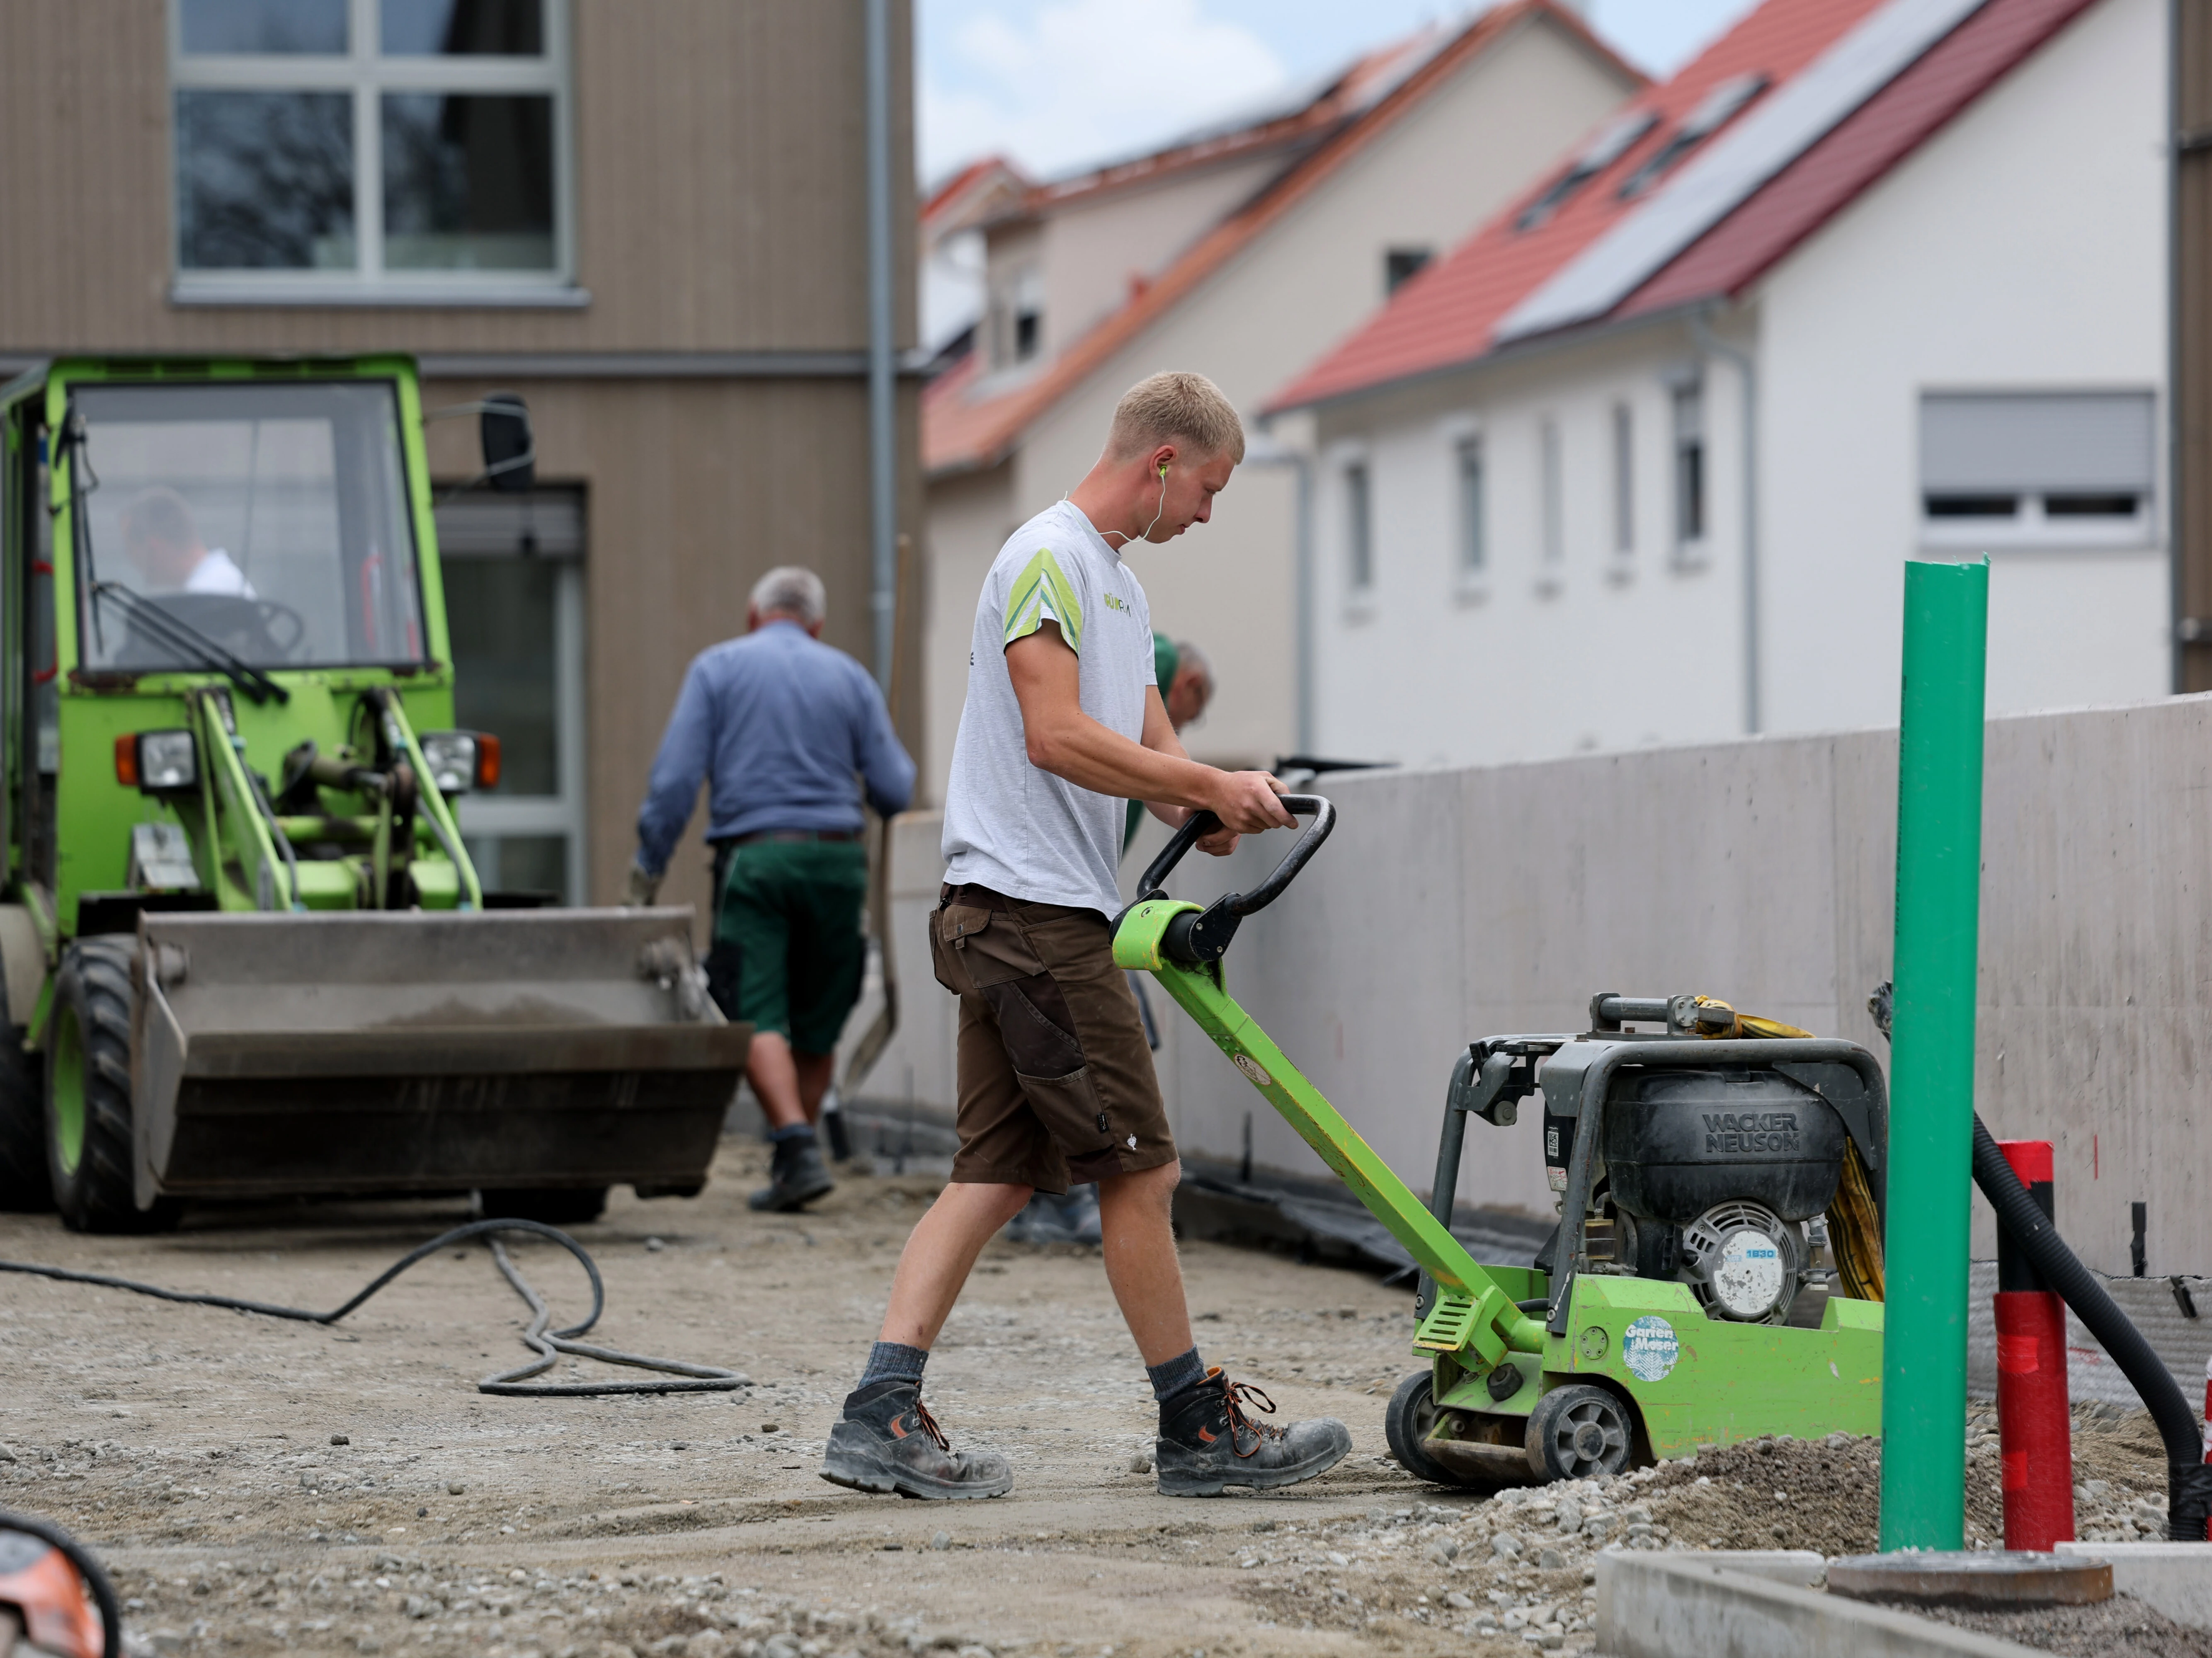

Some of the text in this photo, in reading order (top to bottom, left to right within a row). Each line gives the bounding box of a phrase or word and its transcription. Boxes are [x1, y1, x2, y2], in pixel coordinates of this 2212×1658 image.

[1702, 1112, 1799, 1132] WACKER
[1705, 1132, 1800, 1152] NEUSON
[1635, 1337, 1679, 1351] Moser
